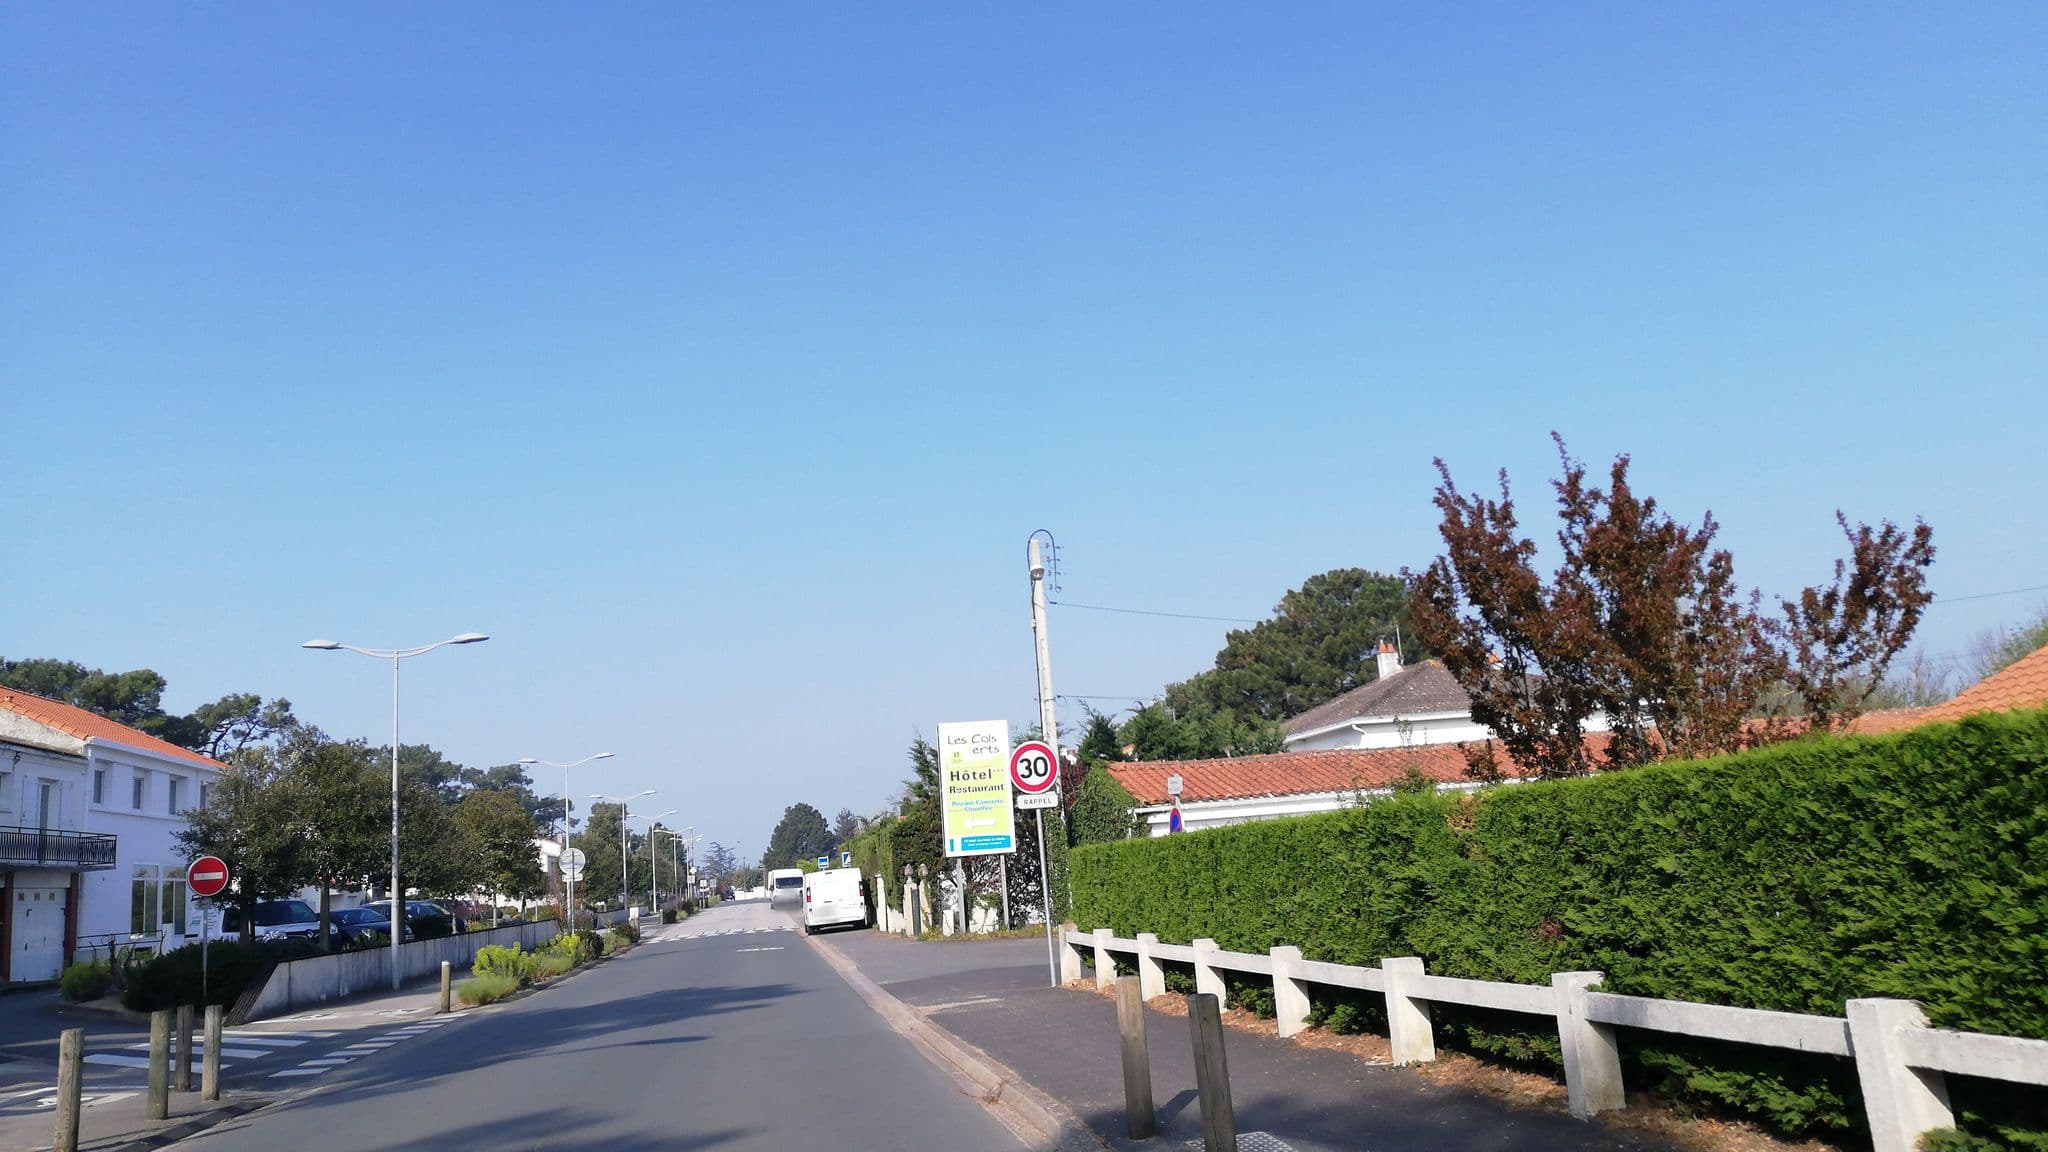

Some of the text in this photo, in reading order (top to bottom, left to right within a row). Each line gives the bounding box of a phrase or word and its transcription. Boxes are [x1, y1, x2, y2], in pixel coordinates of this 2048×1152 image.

[947, 733, 997, 744] Les Cols
[1019, 756, 1049, 779] 30
[950, 768, 992, 782] Hôtel
[949, 783, 1005, 794] Restaurant
[1023, 797, 1052, 806] RAPPEL
